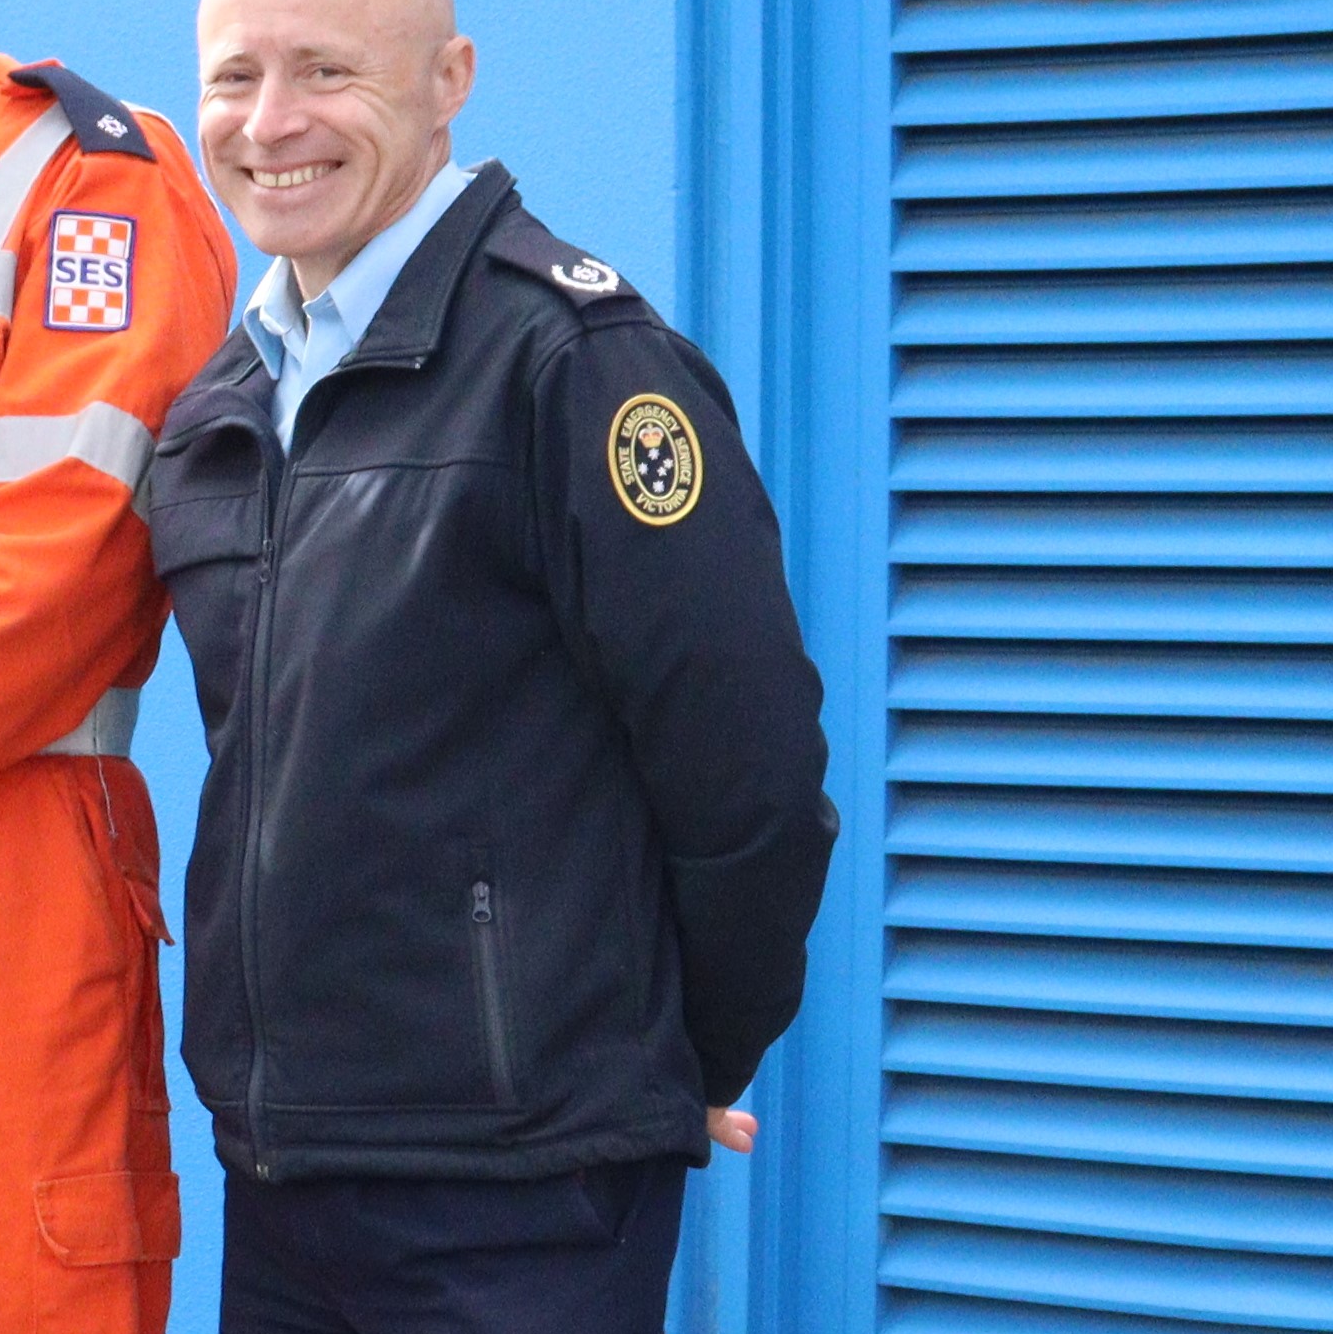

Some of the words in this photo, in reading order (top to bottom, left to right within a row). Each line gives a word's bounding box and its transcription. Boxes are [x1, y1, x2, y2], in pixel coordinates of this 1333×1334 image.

[55, 257, 123, 287] SES
[621, 405, 681, 437] EMERGENCY
[618, 446, 635, 486] STATE
[675, 436, 692, 486] SERVICE
[636, 488, 688, 514] VICTORIA
